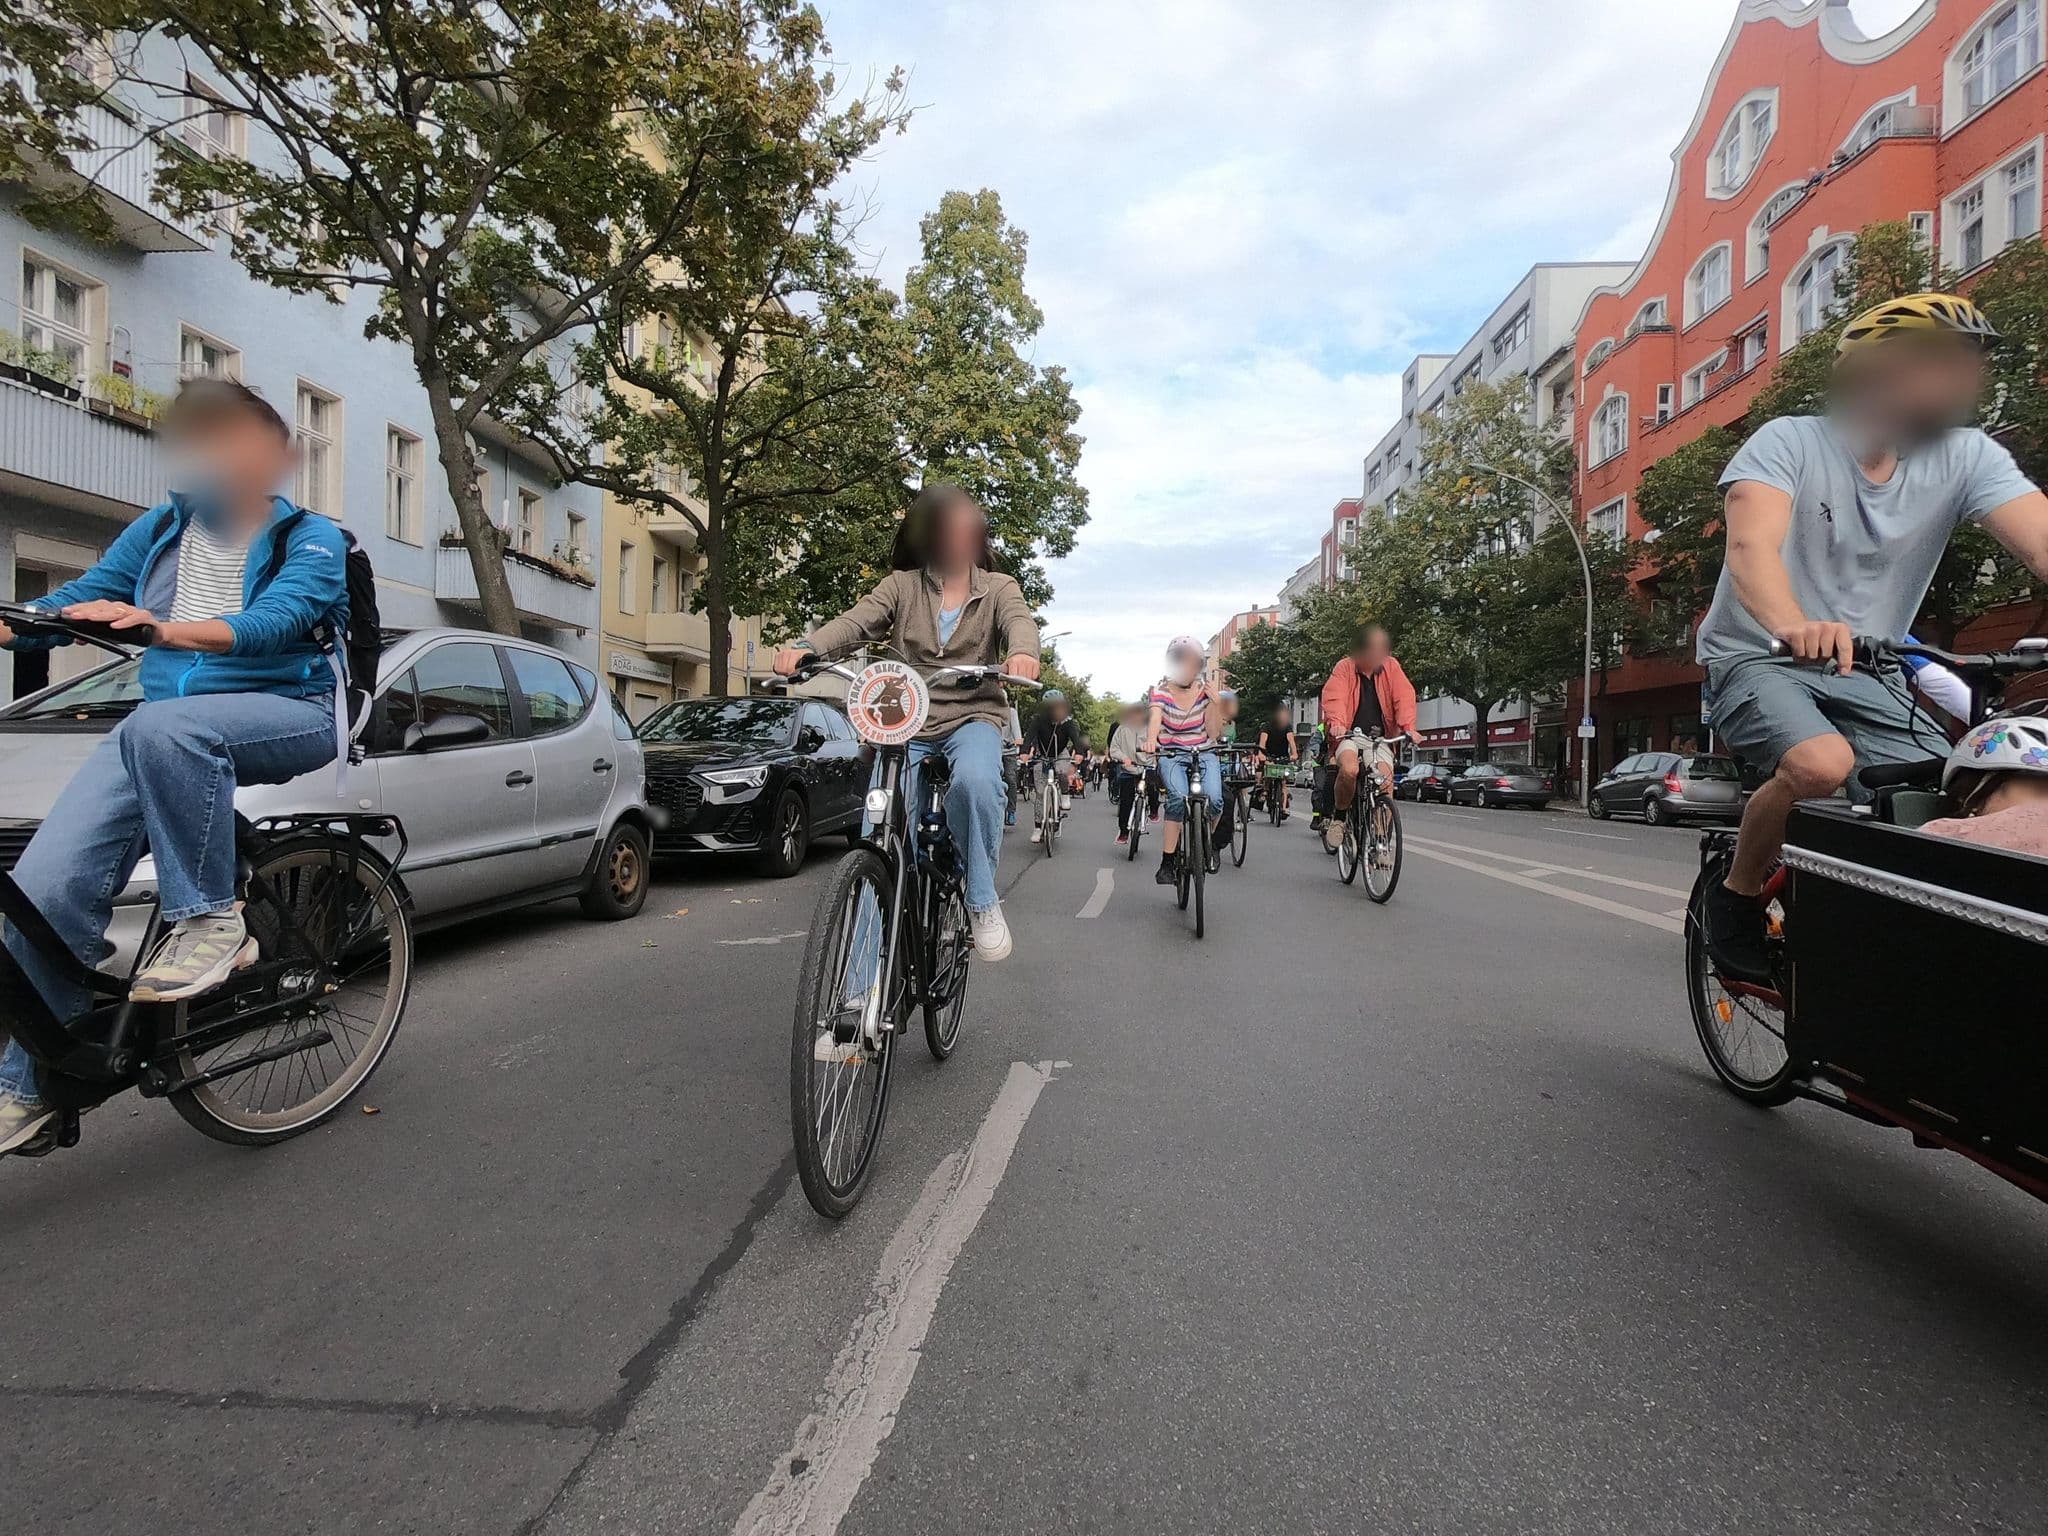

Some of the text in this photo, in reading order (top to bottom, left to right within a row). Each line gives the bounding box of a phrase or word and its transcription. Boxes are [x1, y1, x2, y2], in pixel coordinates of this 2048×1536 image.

[849, 677, 866, 705] TAKE
[874, 664, 902, 674] BIKE
[850, 708, 884, 742] BERLIN
